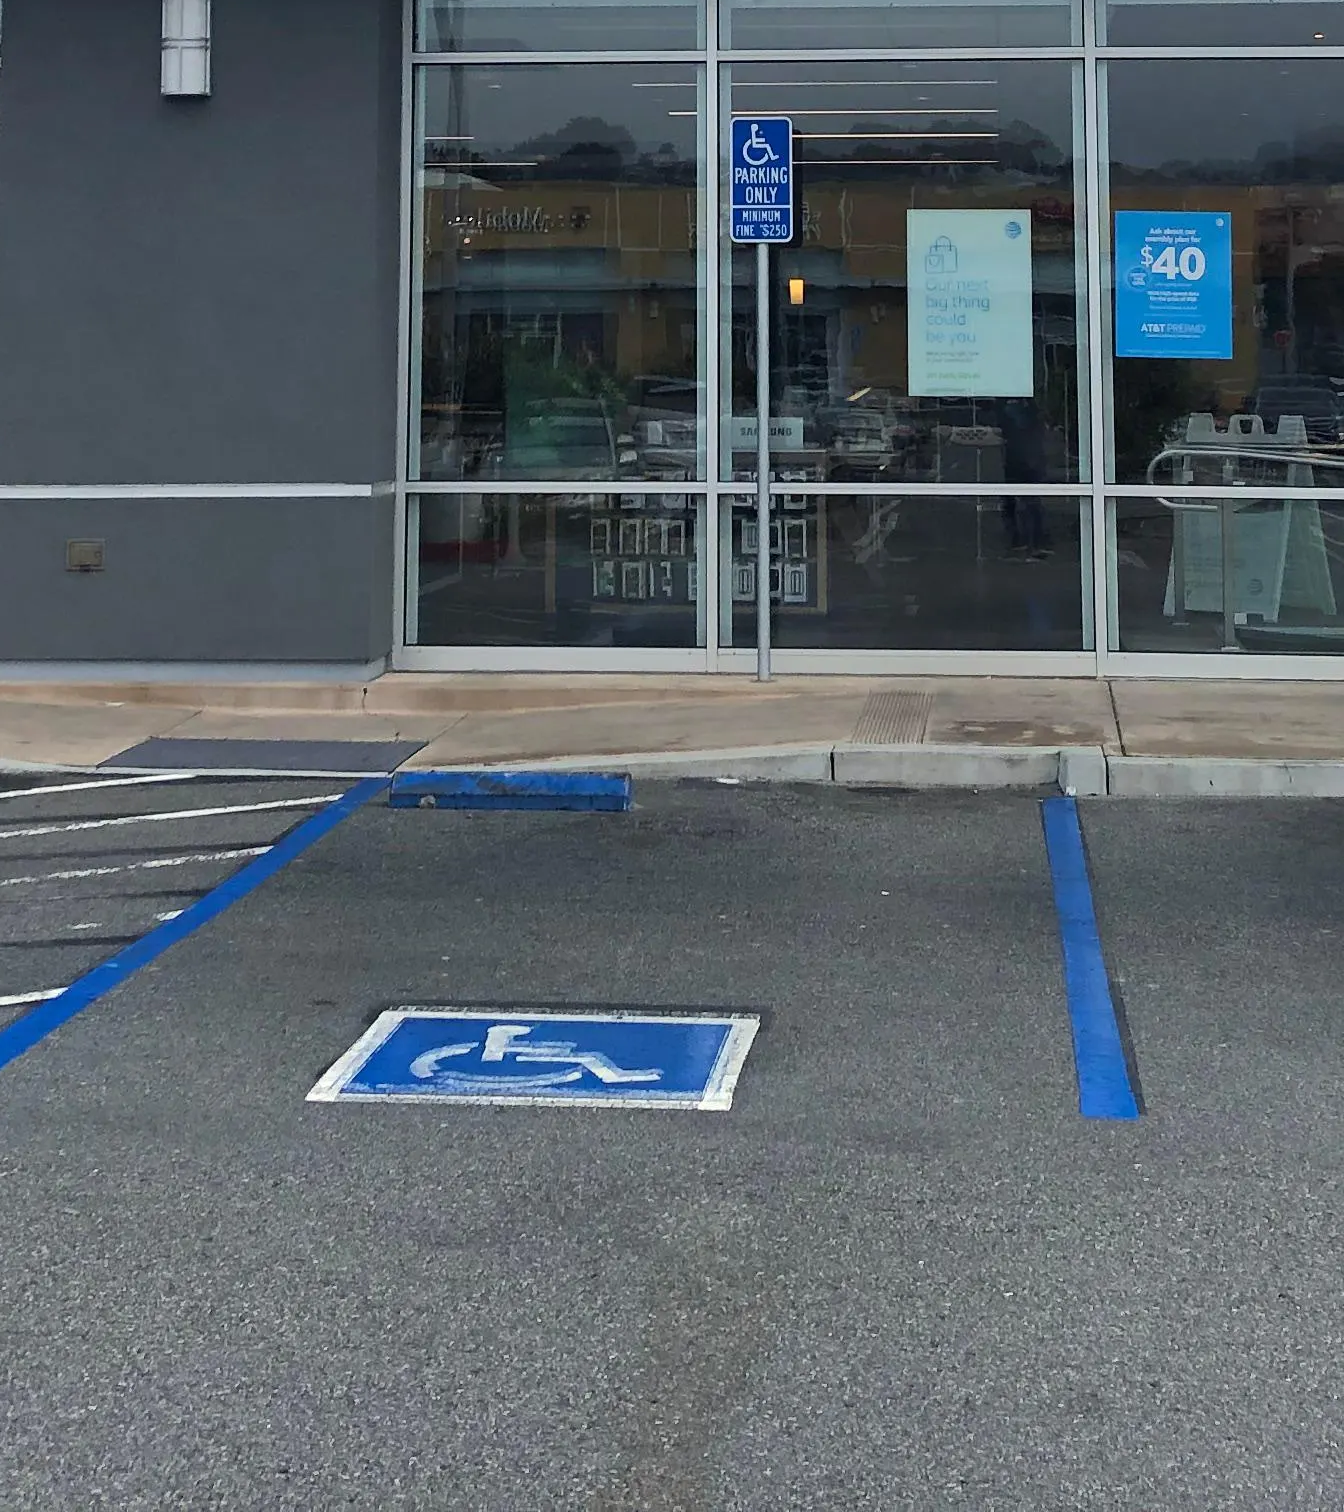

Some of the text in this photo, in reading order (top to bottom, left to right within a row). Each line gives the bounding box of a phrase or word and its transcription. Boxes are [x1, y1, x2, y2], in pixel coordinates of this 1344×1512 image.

[734, 167, 788, 184] PARKING
[745, 186, 777, 204] ONLY
[742, 210, 781, 222] MINIMUM
[736, 224, 787, 237] FINE $250
[1140, 244, 1206, 281] $40
[952, 295, 990, 312] thing
[1141, 323, 1166, 332] AT&T
